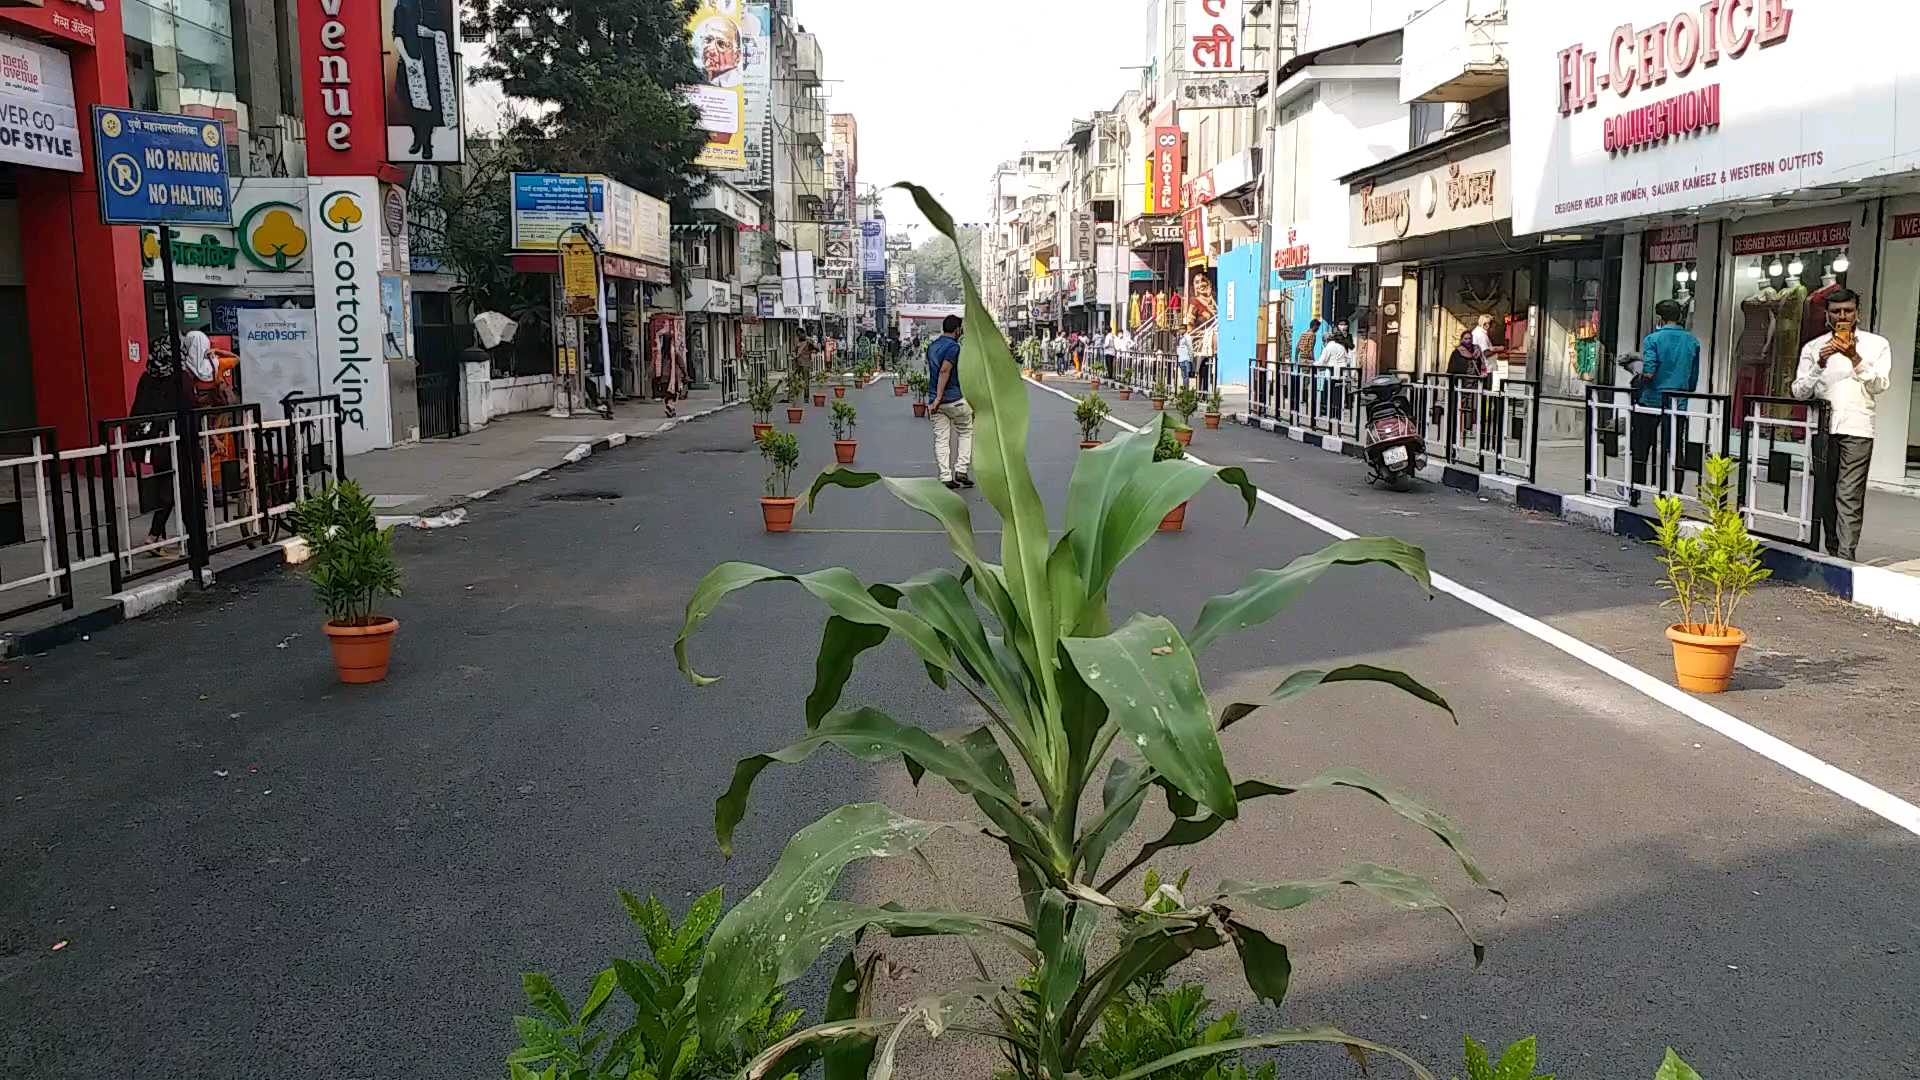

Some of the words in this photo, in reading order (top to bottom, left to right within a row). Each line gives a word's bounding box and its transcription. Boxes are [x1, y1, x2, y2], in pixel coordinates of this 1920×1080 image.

[1, 54, 29, 71] men's
[3, 66, 39, 86] avenue
[32, 110, 55, 131] GO
[1603, 83, 1720, 155] COLLECTION
[0, 127, 21, 147] OF
[23, 132, 74, 158] STYLE
[144, 147, 164, 169] NO
[166, 149, 220, 174] PARKING
[148, 183, 168, 204] NO
[170, 184, 223, 207] HALTING
[1554, 200, 1583, 215] DESIGNER
[1584, 196, 1604, 209] WEAR
[1605, 192, 1619, 206] FOR
[1620, 187, 1650, 202] WOMEN,
[1651, 179, 1680, 199] SALVAR
[1682, 172, 1718, 192] KAMEEZ
[1720, 171, 1727, 184] &
[1729, 161, 1776, 182] WESTERN
[1778, 150, 1825, 173] OUTFITS
[1735, 236, 1765, 252] DESIGNER
[1766, 234, 1786, 249] DRESS
[1786, 229, 1821, 248] MATERIAL
[1822, 230, 1828, 241] &
[331, 241, 374, 432] cottonking
